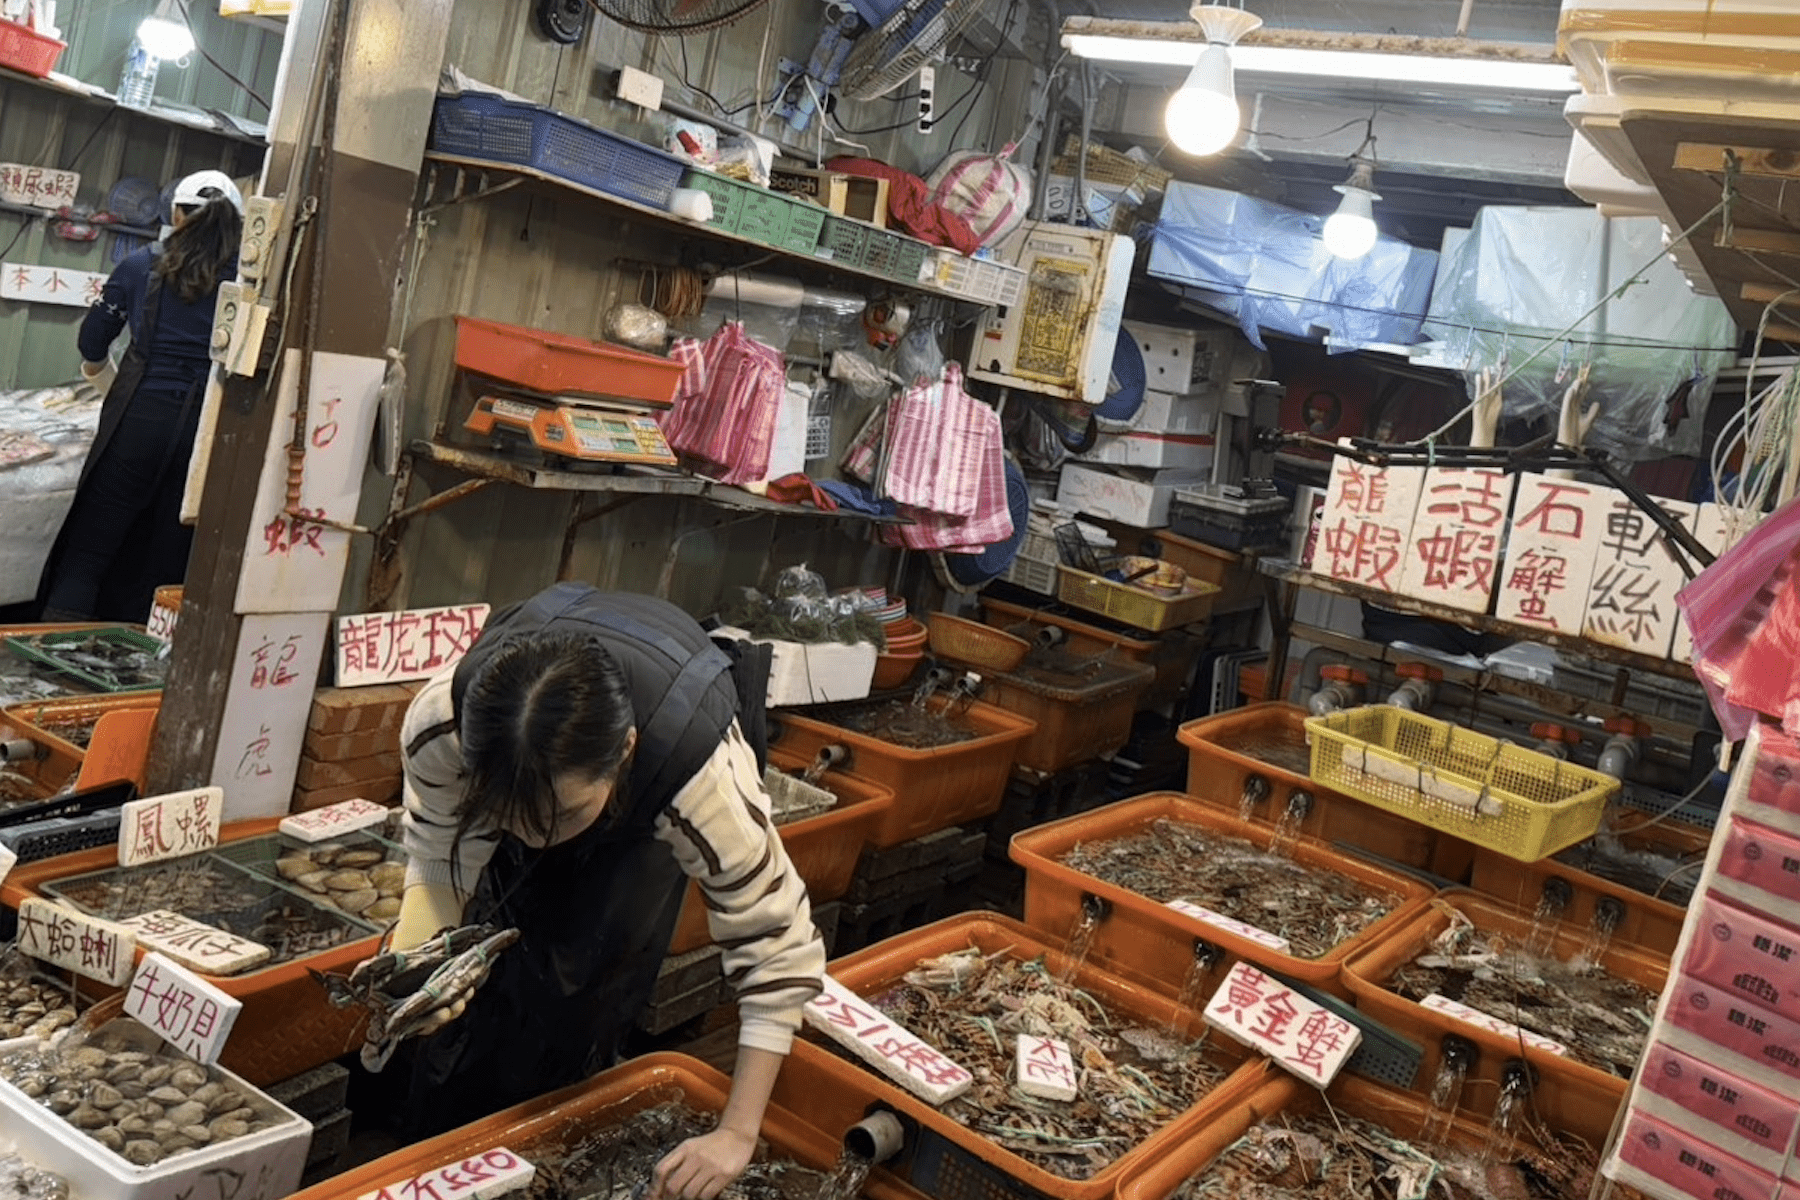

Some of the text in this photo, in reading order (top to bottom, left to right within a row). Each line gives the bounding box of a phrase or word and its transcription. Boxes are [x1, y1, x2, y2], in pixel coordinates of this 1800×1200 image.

[1417, 467, 1508, 595] 活蝦
[1507, 481, 1591, 629] 石蟹
[129, 795, 216, 862] 鳳螺
[133, 965, 218, 1061] 牛奶貝
[1214, 968, 1351, 1078] 黃金蟹
